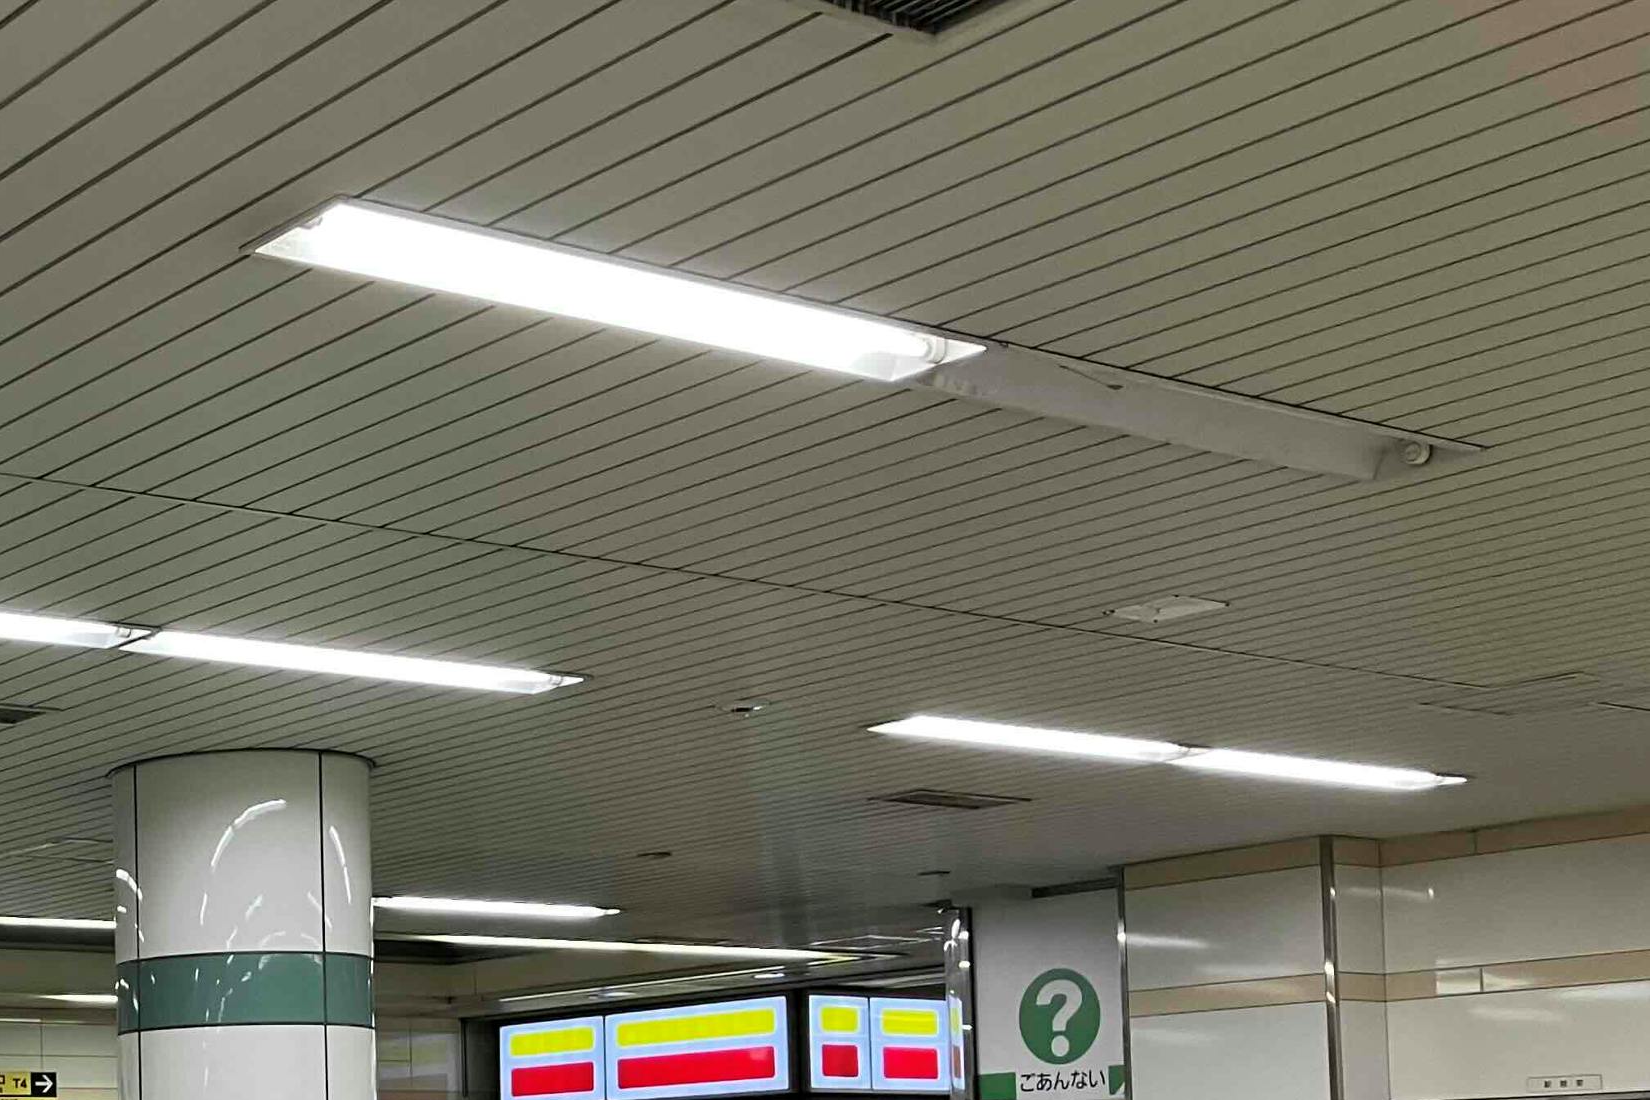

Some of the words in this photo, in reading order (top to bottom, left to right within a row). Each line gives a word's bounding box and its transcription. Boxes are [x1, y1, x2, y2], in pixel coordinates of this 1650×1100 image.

[12, 1078, 28, 1089] T4
[1020, 1069, 1106, 1092] ごあんない
